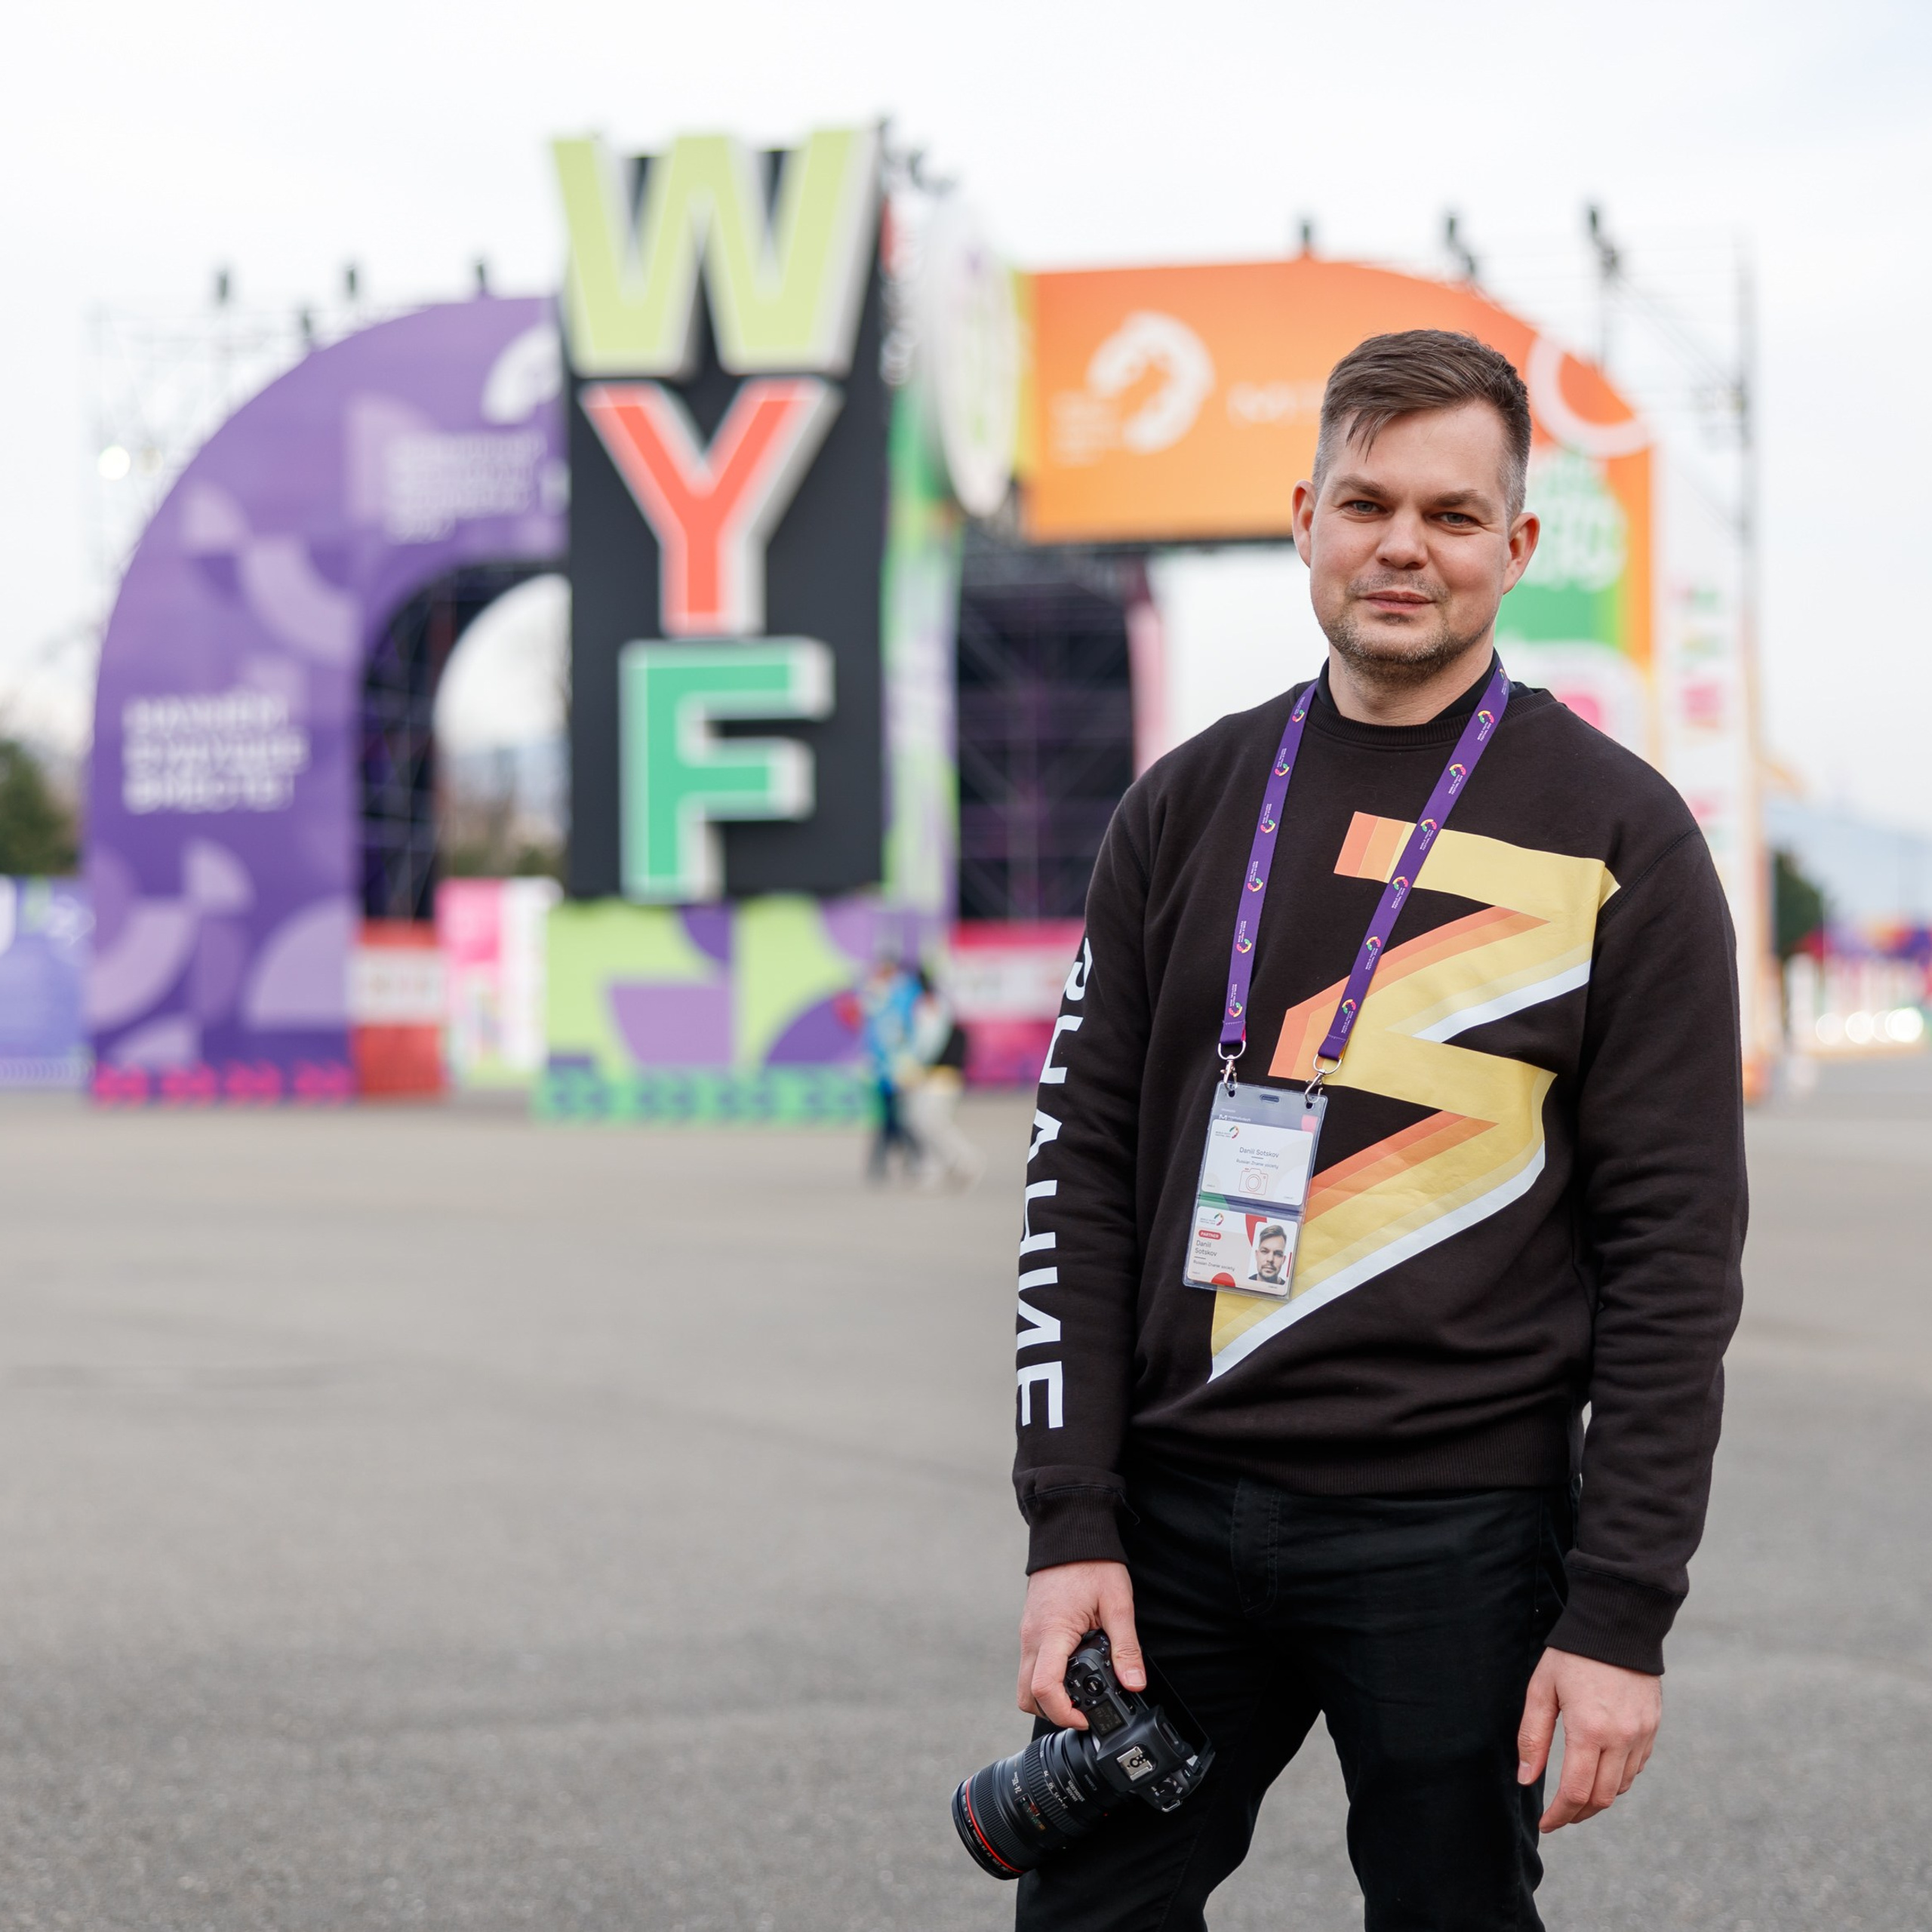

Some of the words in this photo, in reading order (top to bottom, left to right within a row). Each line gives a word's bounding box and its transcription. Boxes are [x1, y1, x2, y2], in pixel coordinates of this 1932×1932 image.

[1256, 1149, 1279, 1158] Sotskov
[1195, 1247, 1217, 1257] Sotskov
[1066, 1786, 1078, 1801] IMAGE
[1068, 1780, 1085, 1802] STABILIZER
